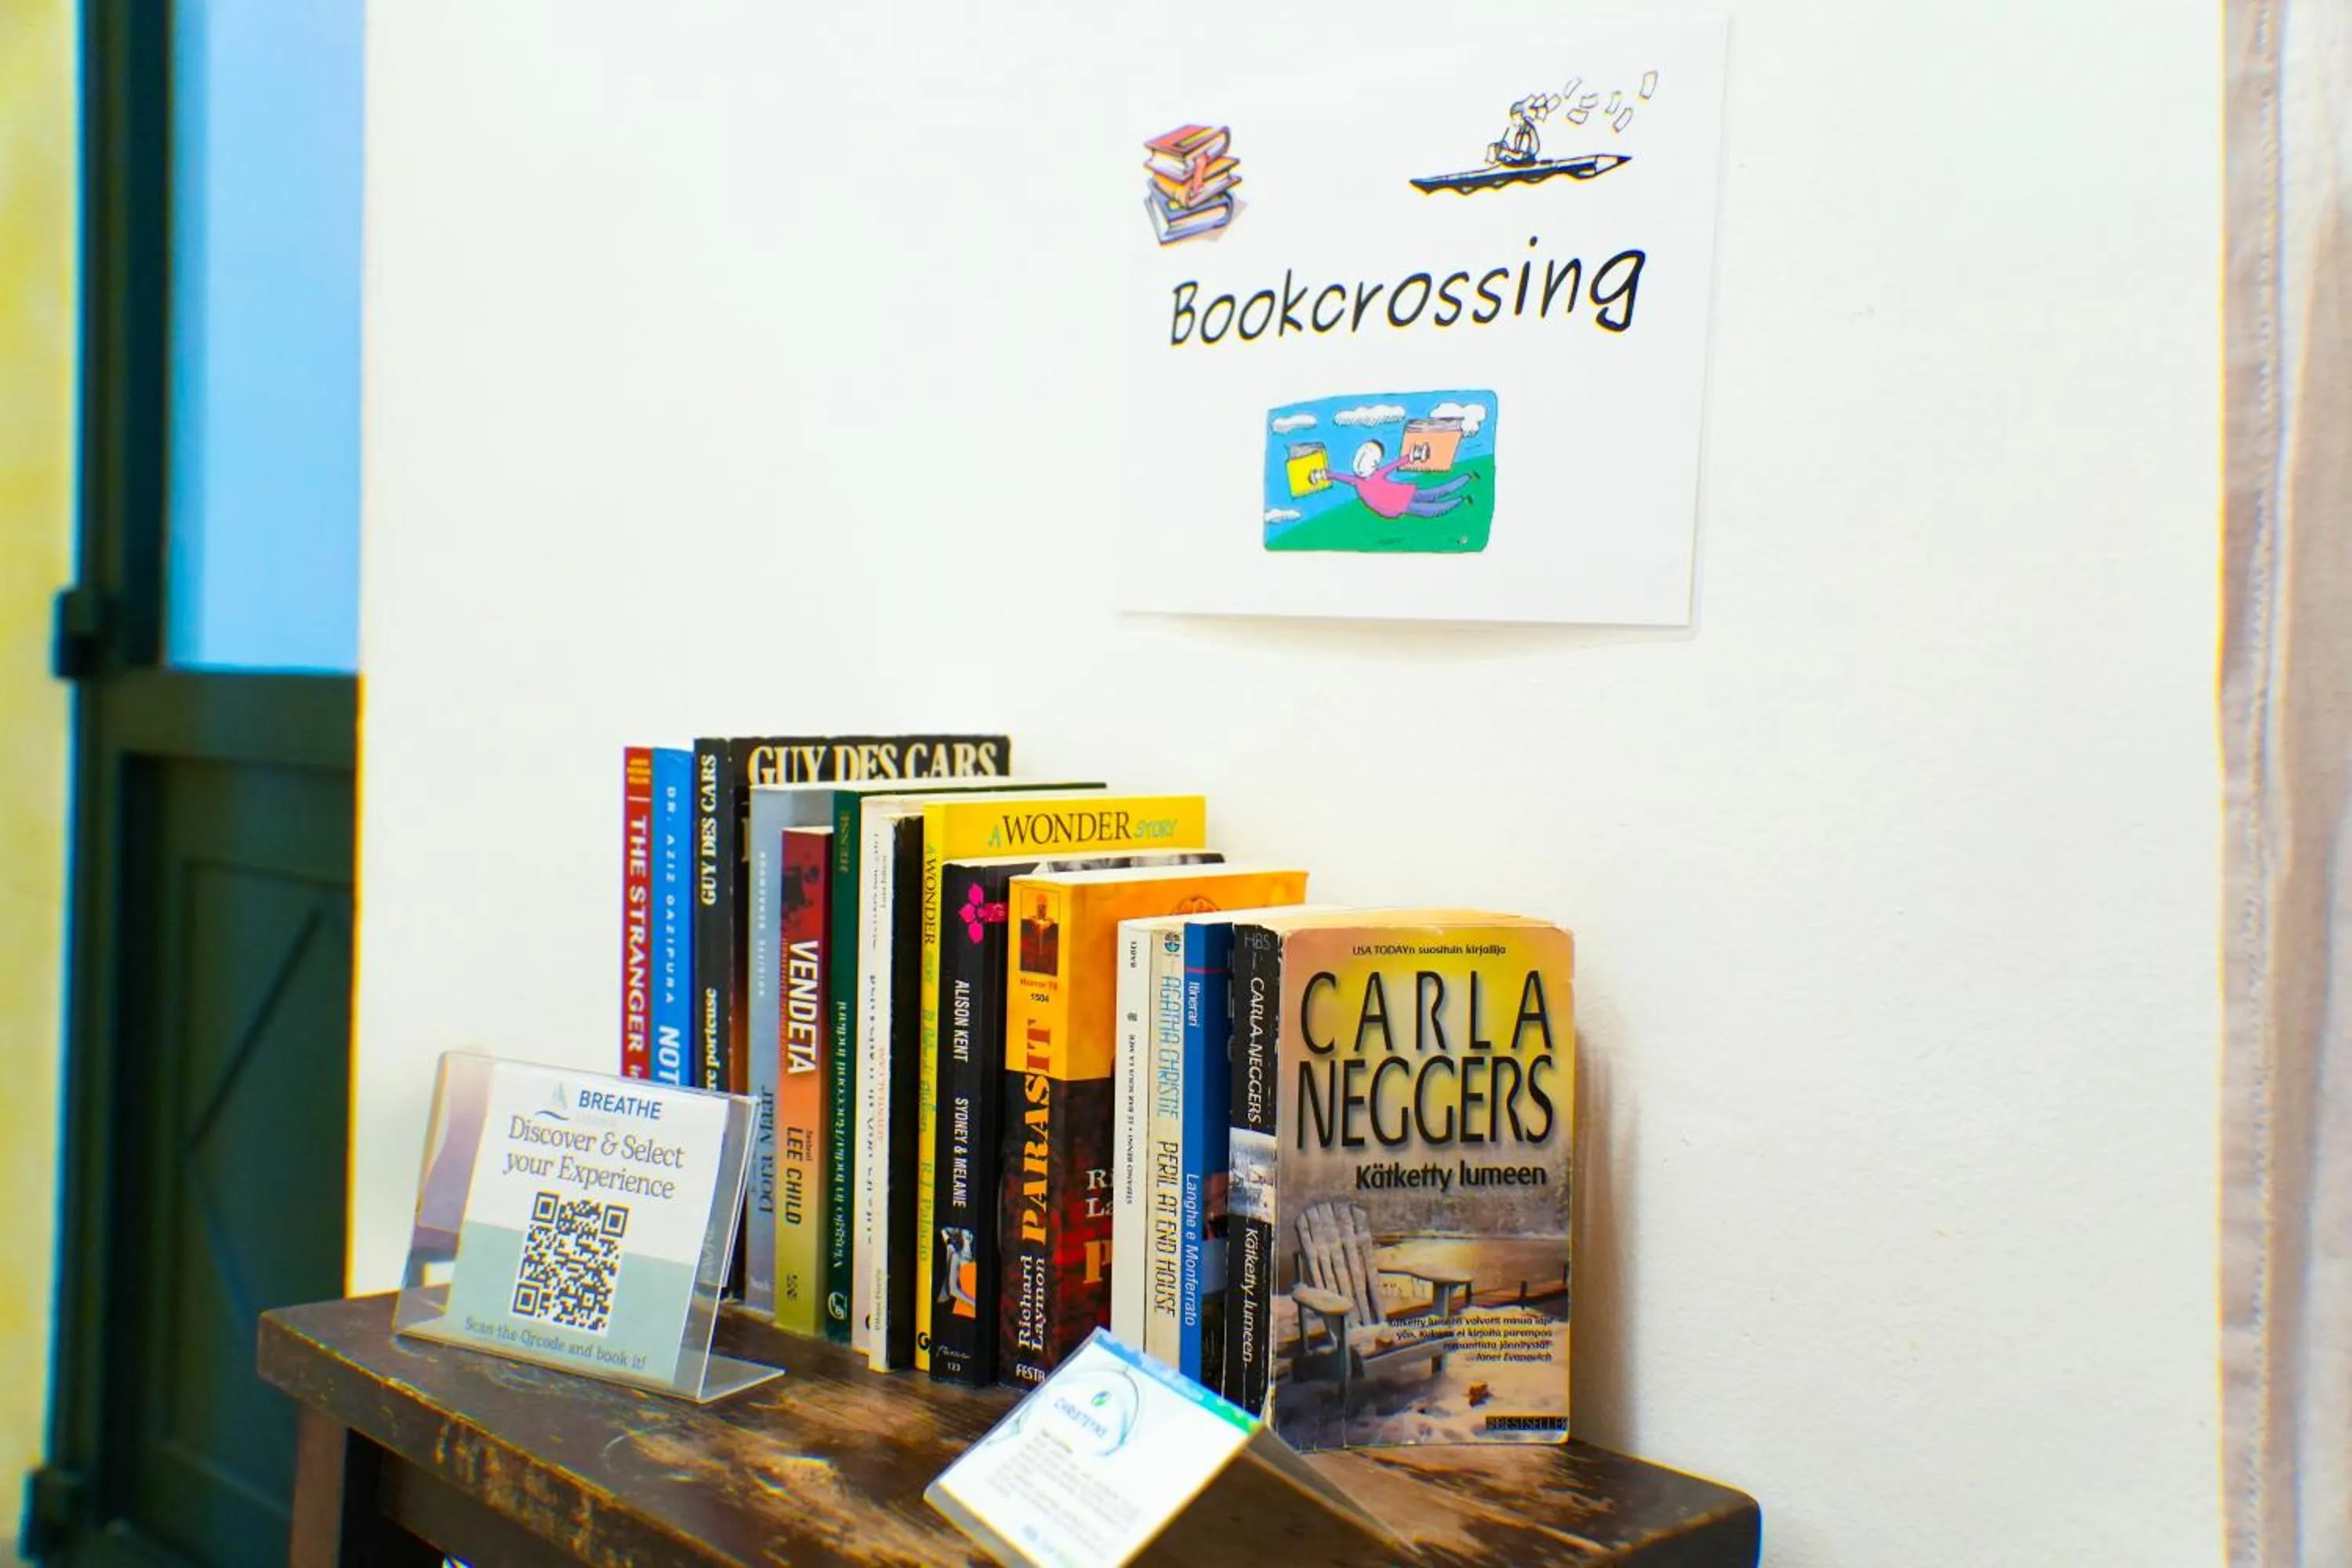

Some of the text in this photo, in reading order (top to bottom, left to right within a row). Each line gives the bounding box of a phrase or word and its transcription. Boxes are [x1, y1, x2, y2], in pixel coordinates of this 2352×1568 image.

[1171, 237, 1646, 346] Bookcrossing
[747, 742, 997, 785] GUY DES CARS
[629, 815, 647, 877] THE
[700, 754, 717, 906] GUY DES CARS
[1003, 811, 1132, 846] WONDER
[665, 786, 677, 1004] DR. AZIZ GAZIPURA
[925, 857, 938, 946] WONDER
[627, 885, 646, 1052] STRANGER
[1352, 946, 1372, 956] USA
[1418, 945, 1463, 955] suosituin
[1465, 944, 1506, 957] kirjailija
[703, 988, 720, 1068] porteuse
[787, 940, 820, 1076] VENDETA
[953, 980, 970, 1062] ALISON KENT
[1188, 981, 1201, 1027] Itinerari
[1301, 971, 1553, 1055] CARLA
[659, 1025, 681, 1085] NOT
[1156, 976, 1181, 1120] AGATHA CHRISTIE
[1247, 977, 1265, 1123] CARLA NEGGERS
[508, 1115, 685, 1169] Discover & Select
[579, 1089, 663, 1120] BREATHE
[953, 1097, 969, 1143] SYDNEY
[1022, 1019, 1051, 1246] PARASIT
[1297, 1054, 1554, 1150] NEGGERS
[503, 1152, 676, 1200] your Experience
[757, 1085, 775, 1214] Dora Maar
[785, 1126, 804, 1225] LEE CHILD
[952, 1156, 968, 1207] MELANIE
[1355, 1160, 1548, 1192] Kätketty lumeen
[1154, 1141, 1179, 1317] PERIL AT END HOUSE
[1183, 1174, 1200, 1226] Langhe
[1018, 1255, 1033, 1348] Richard
[1184, 1245, 1199, 1327] Monferrato
[1240, 1227, 1259, 1295] Kätketty
[464, 1316, 494, 1336] Scan
[497, 1324, 517, 1341] the
[568, 1341, 593, 1359] and
[596, 1345, 628, 1367] book
[1031, 1256, 1047, 1353] Laymon
